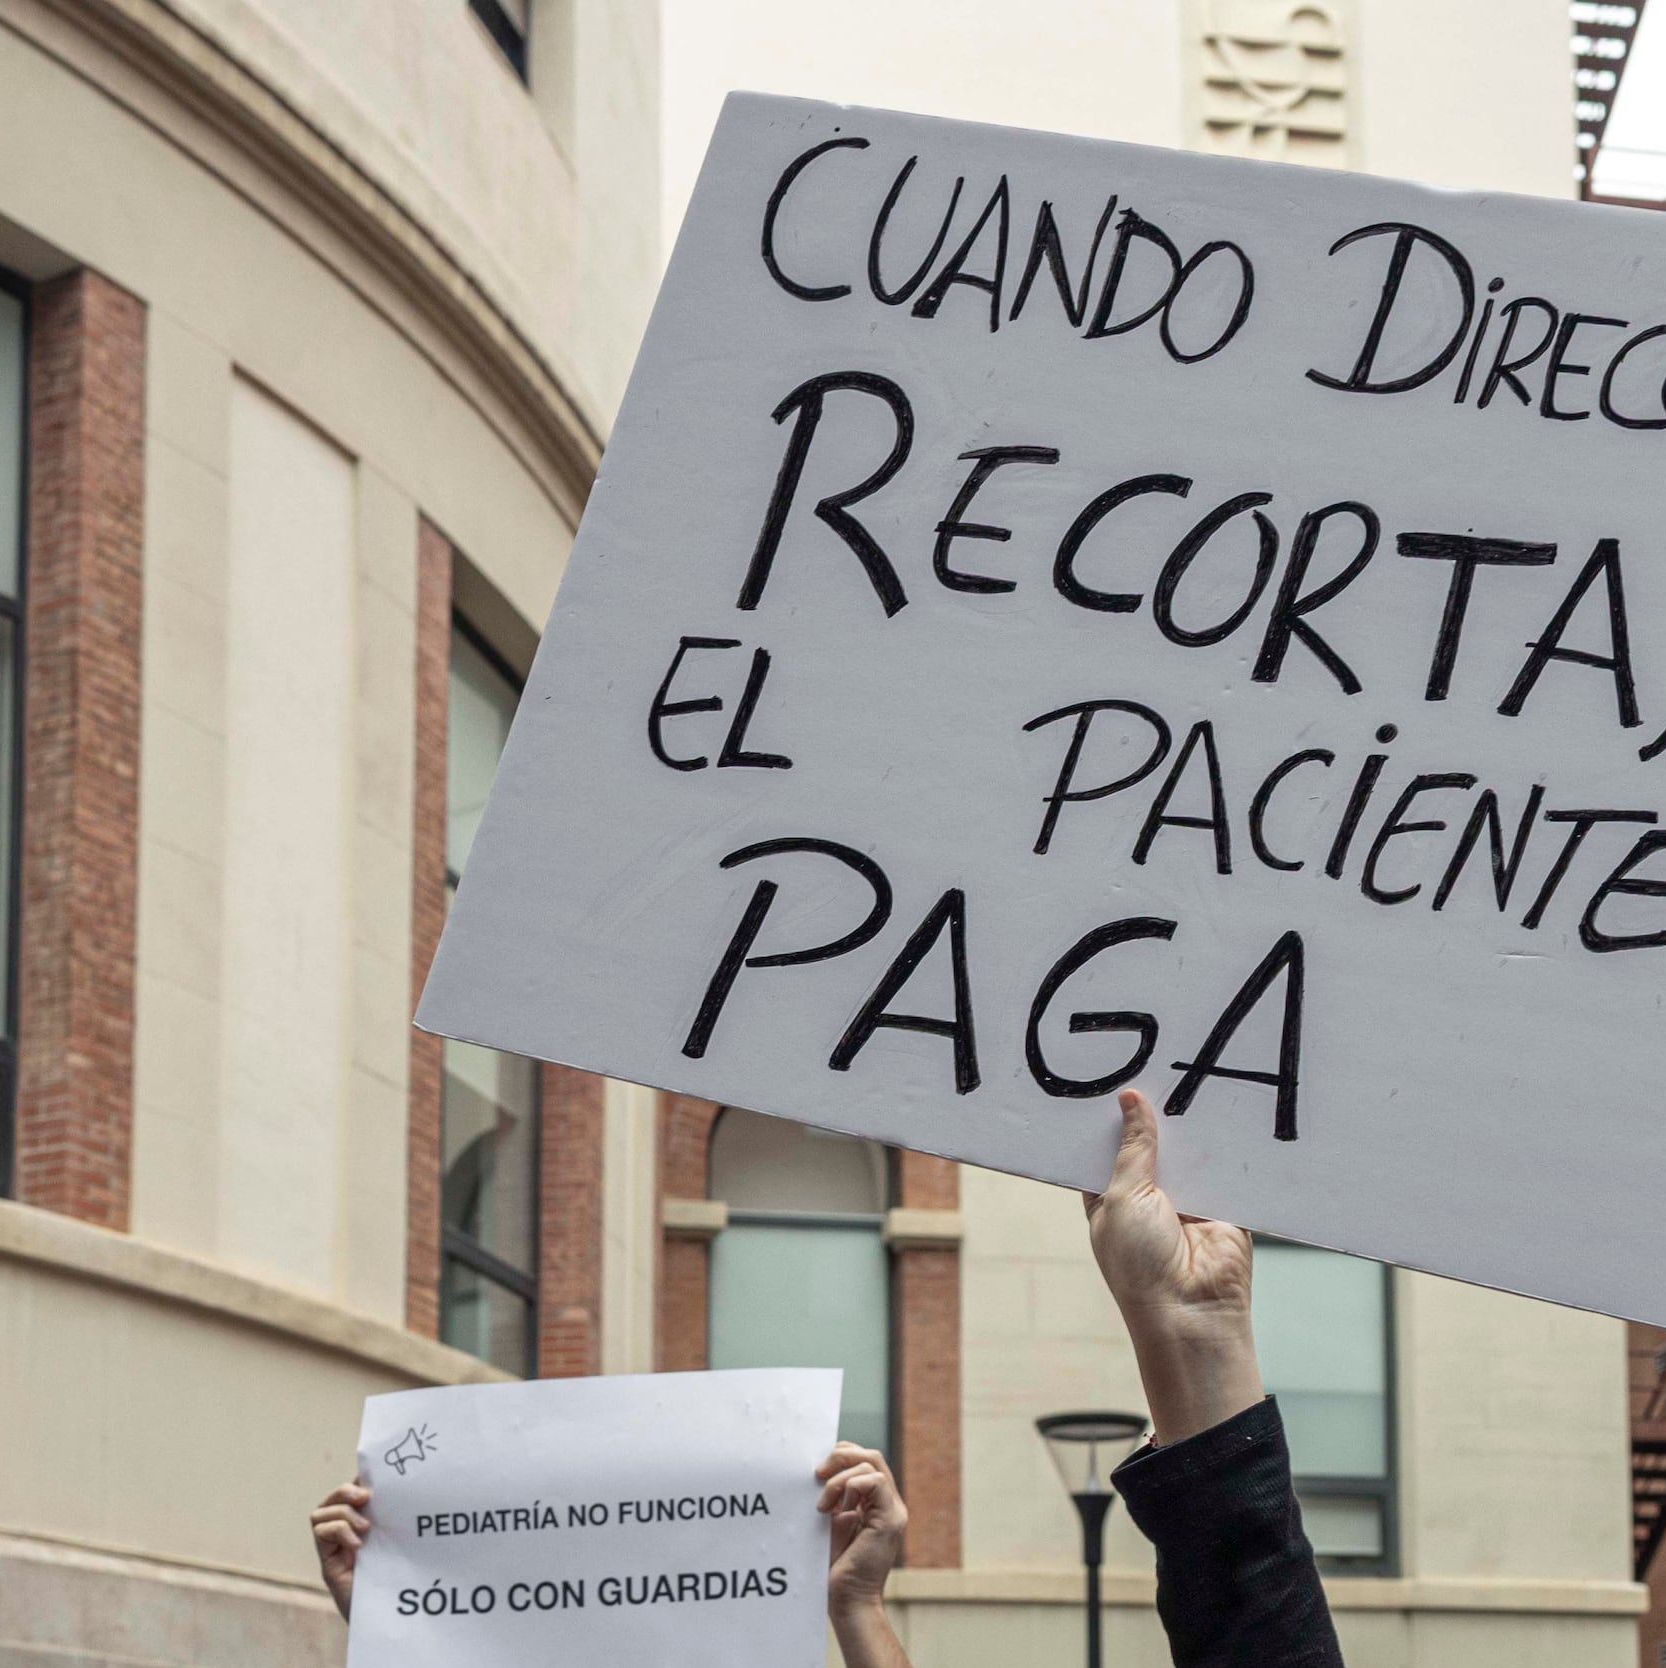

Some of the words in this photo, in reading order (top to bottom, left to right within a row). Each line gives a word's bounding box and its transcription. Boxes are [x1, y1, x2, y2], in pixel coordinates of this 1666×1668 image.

[762, 138, 1254, 364] CUANDO
[648, 636, 792, 771] EL
[682, 838, 1304, 1141] PAGA
[416, 1500, 560, 1537] PEDIATRÍA
[568, 1503, 609, 1527] NO
[618, 1492, 770, 1525] FUNCIONA
[397, 1577, 496, 1616] SÓLO
[507, 1579, 585, 1612] CON
[597, 1566, 788, 1607] GUARDIAS
